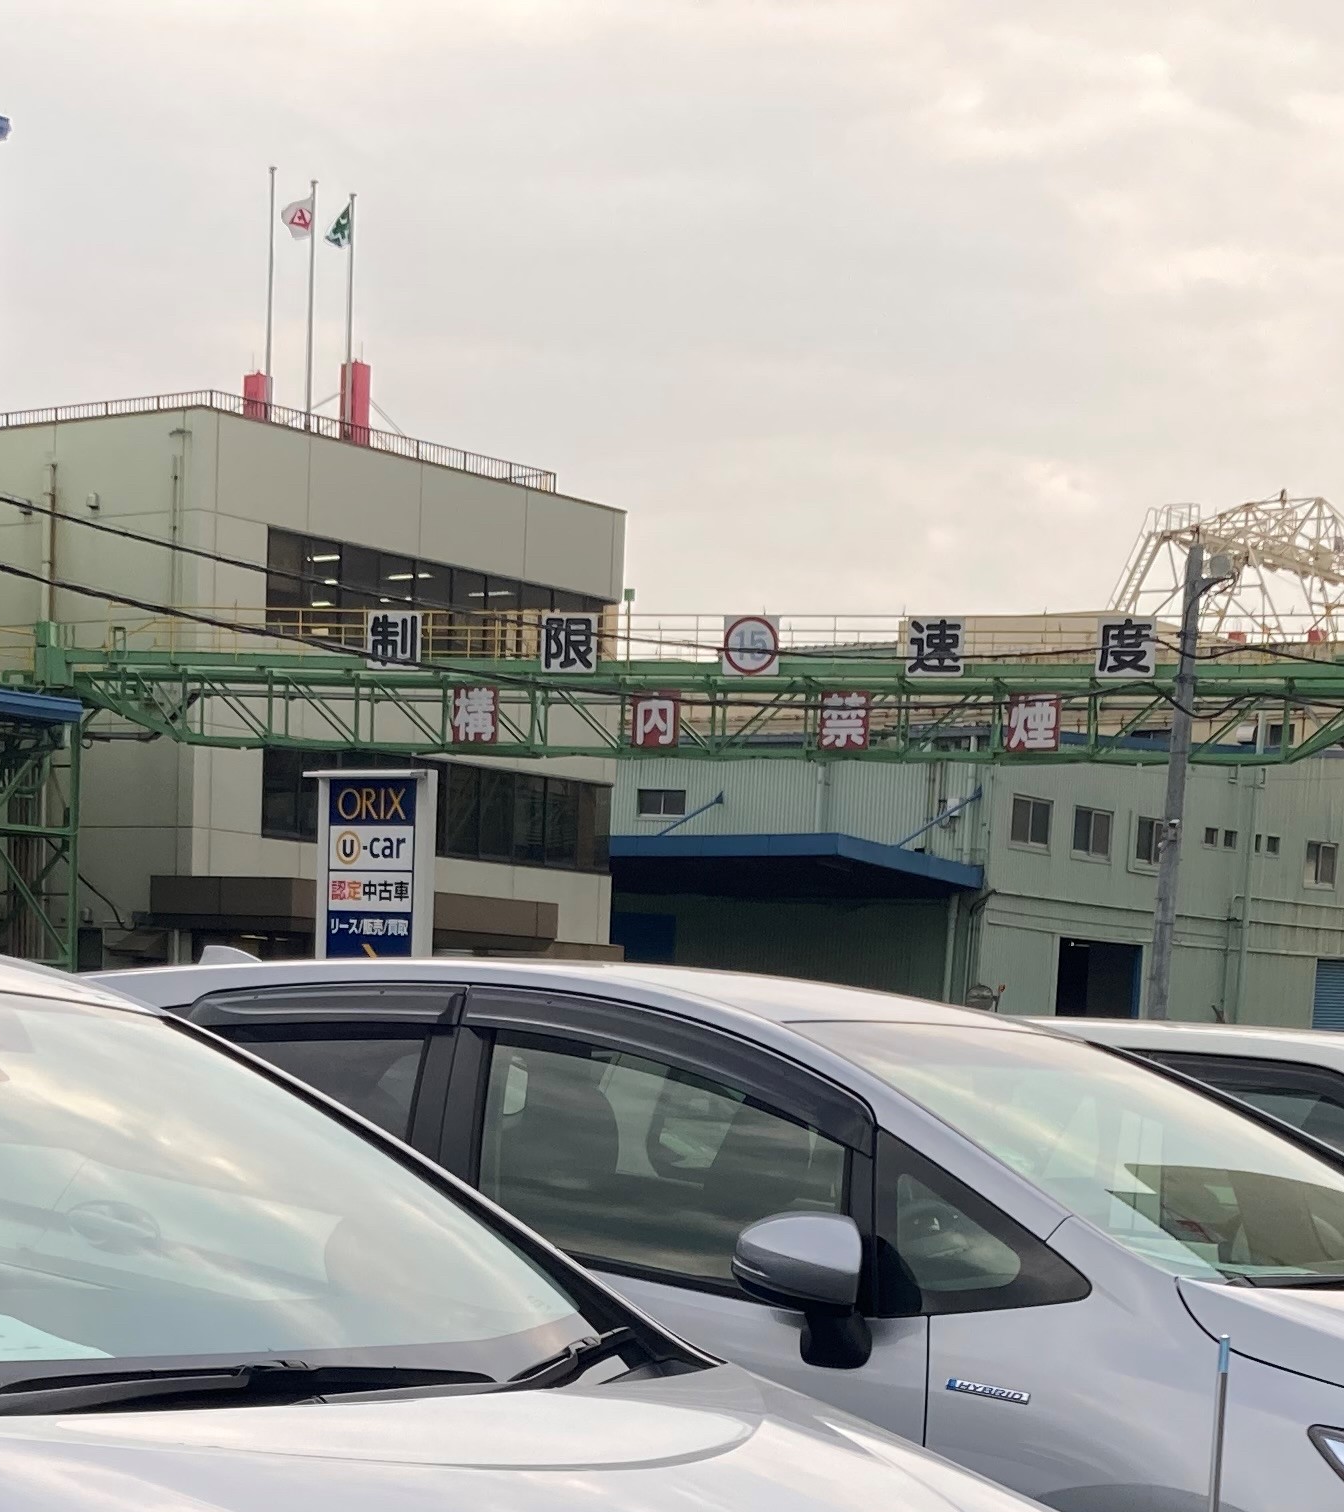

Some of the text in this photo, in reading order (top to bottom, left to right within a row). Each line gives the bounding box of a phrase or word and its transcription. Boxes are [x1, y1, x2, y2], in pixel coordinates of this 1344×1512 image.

[371, 614, 1153, 674] 制 限 15 速 度
[454, 687, 1057, 750] 構 内 禁 煙
[336, 787, 407, 821] ORIX
[331, 880, 410, 902] 認定中古車
[957, 1381, 1024, 1401] HYBRID
